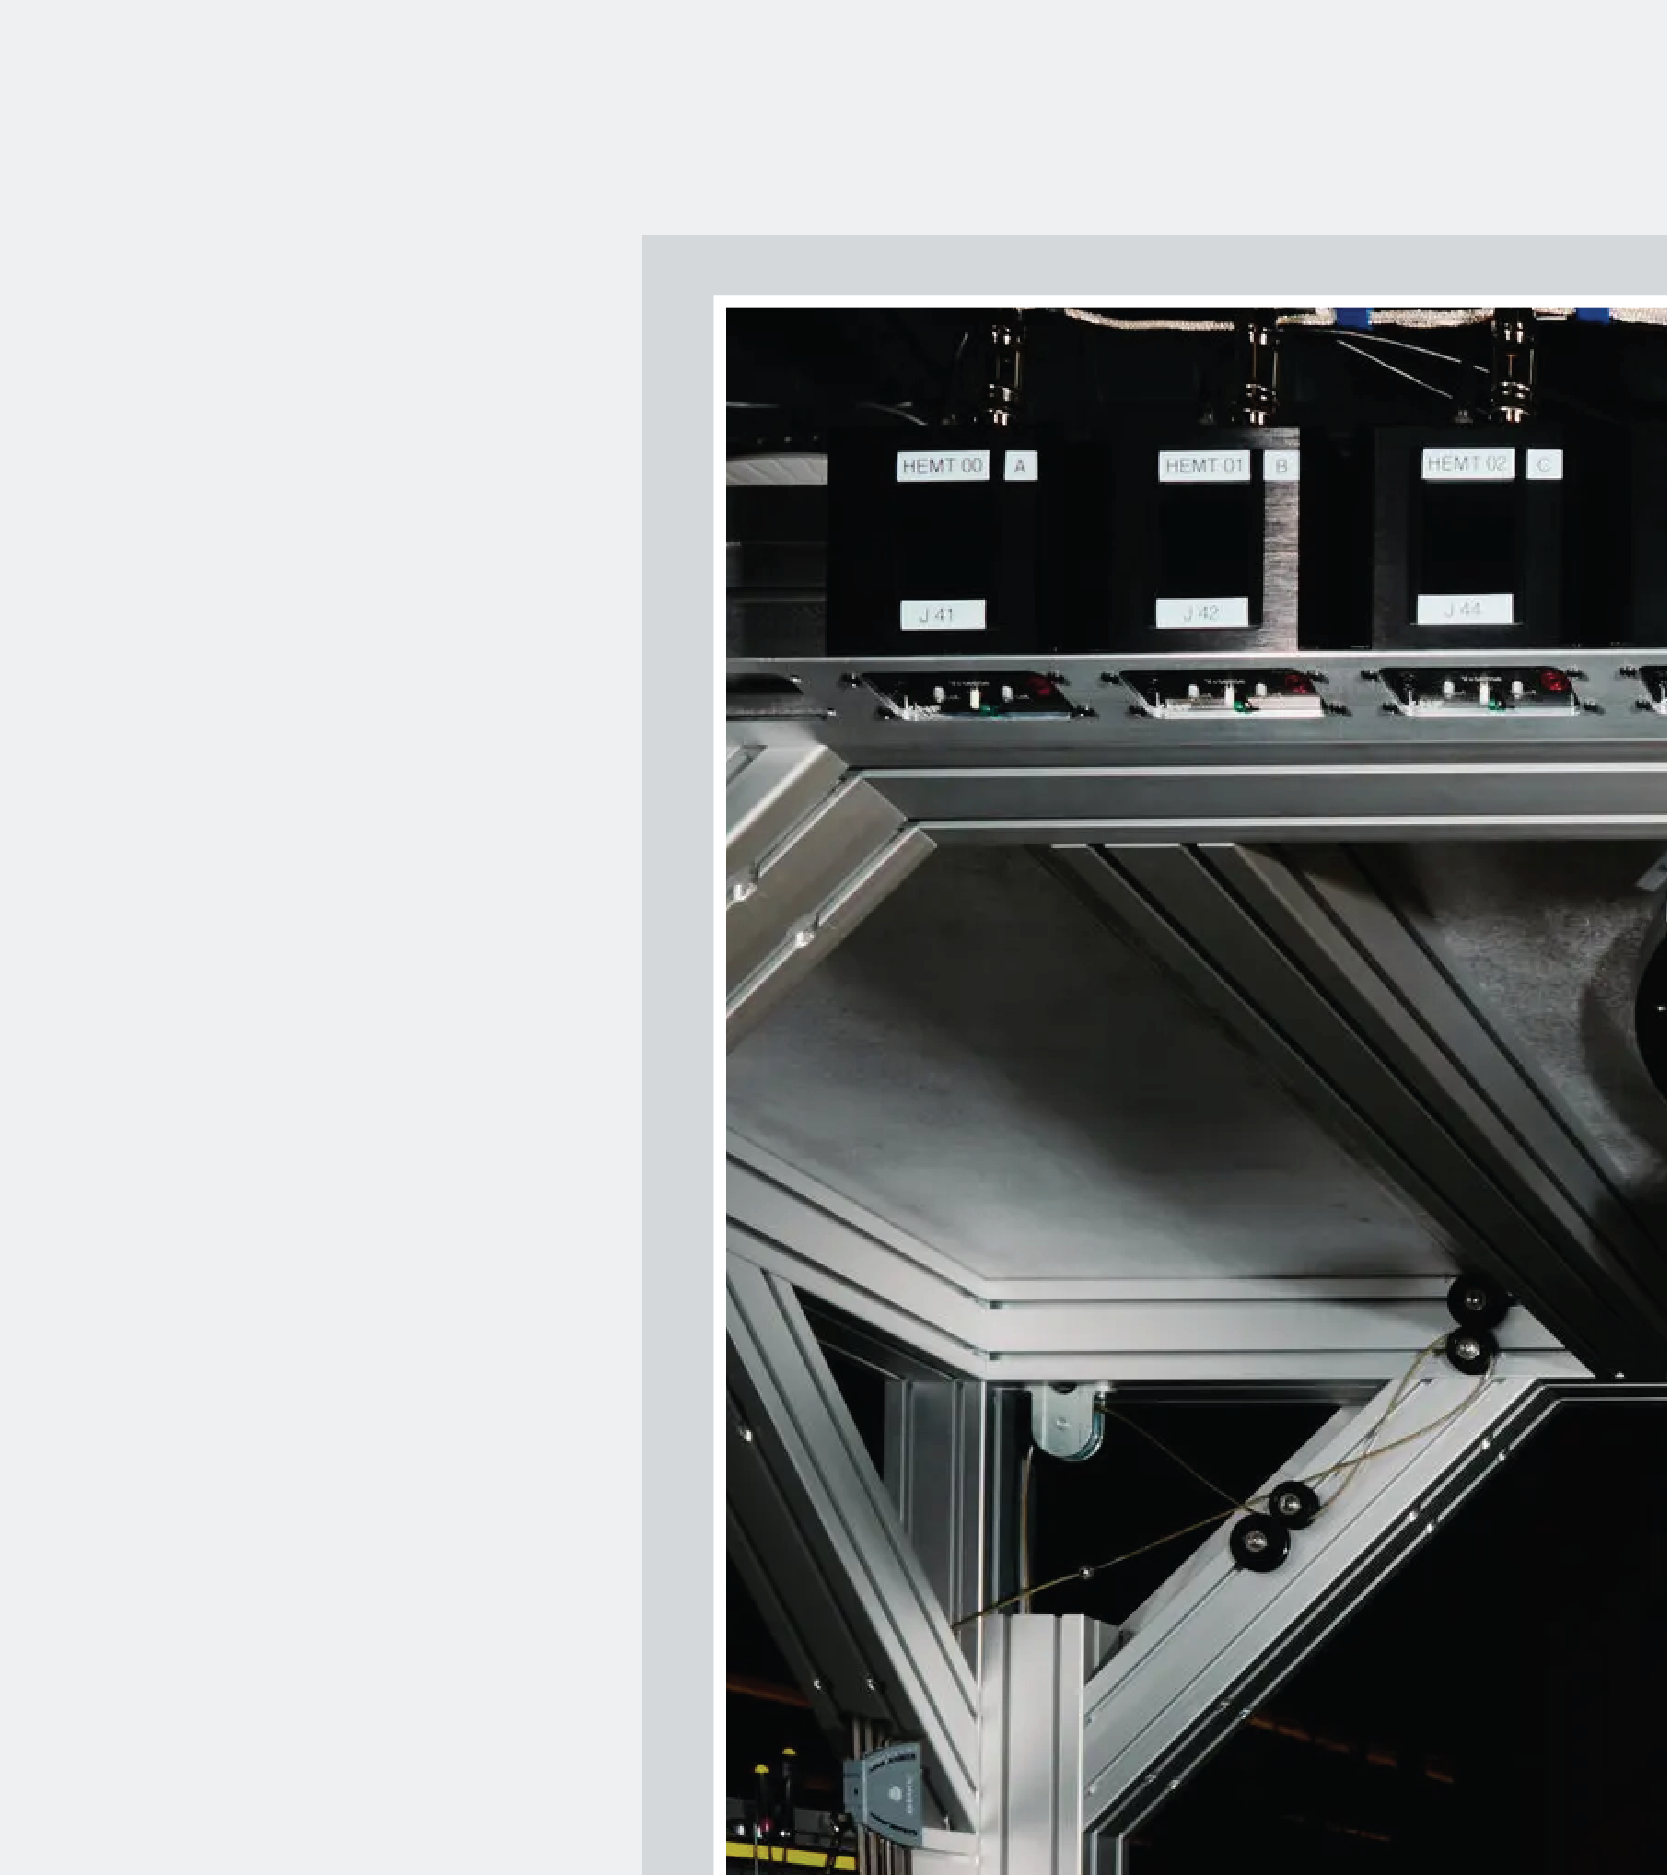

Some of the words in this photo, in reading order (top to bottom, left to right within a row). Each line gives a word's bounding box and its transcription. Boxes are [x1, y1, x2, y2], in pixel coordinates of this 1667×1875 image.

[903, 457, 955, 474] HEMT
[960, 457, 983, 474] 00
[1013, 459, 1026, 474] A
[1166, 459, 1218, 473] HEMT
[1223, 459, 1243, 473] 01
[1276, 460, 1288, 473] B
[1428, 456, 1479, 471] HEMT
[1485, 456, 1508, 471] 02
[1537, 457, 1551, 472] C
[919, 607, 929, 624] J
[933, 607, 954, 623] 41
[1183, 606, 1192, 623] J
[1197, 605, 1220, 622] 42
[1444, 602, 1454, 619] J
[1459, 602, 1483, 617] 44
